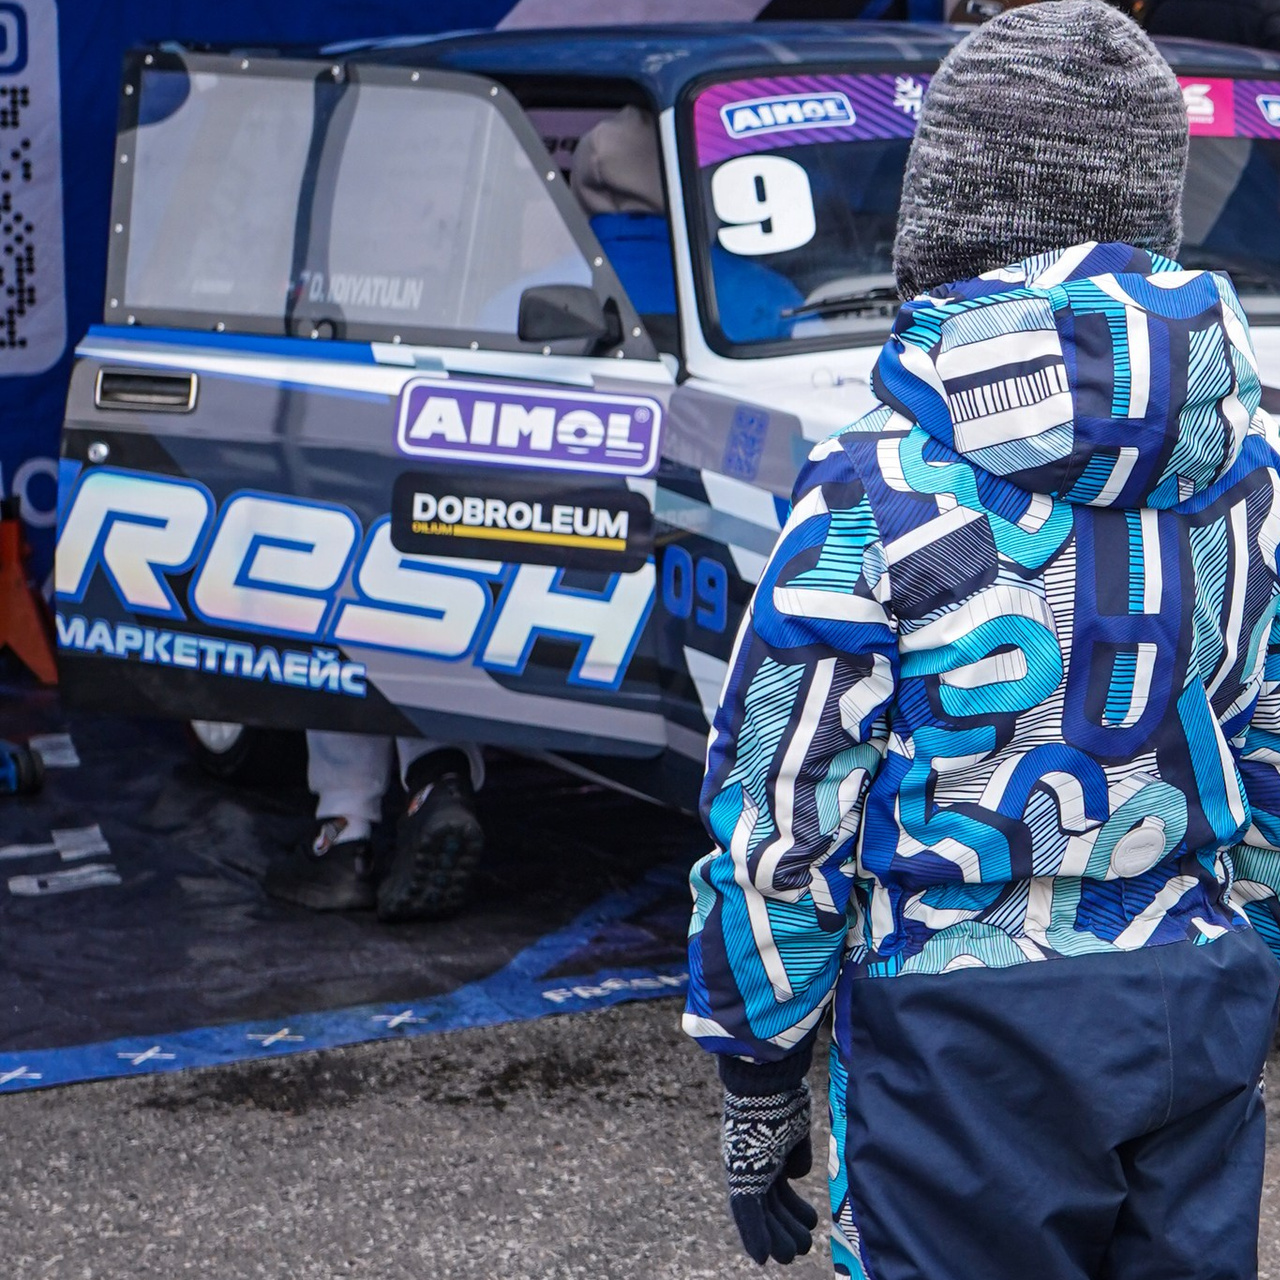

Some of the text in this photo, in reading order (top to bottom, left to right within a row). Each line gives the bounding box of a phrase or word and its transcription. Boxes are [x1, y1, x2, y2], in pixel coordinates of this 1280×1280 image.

[732, 97, 851, 134] AIMOL
[711, 154, 817, 257] 9
[409, 396, 645, 460] AIMOL
[412, 492, 629, 540] DOBROLEUM
[662, 544, 729, 634] 09
